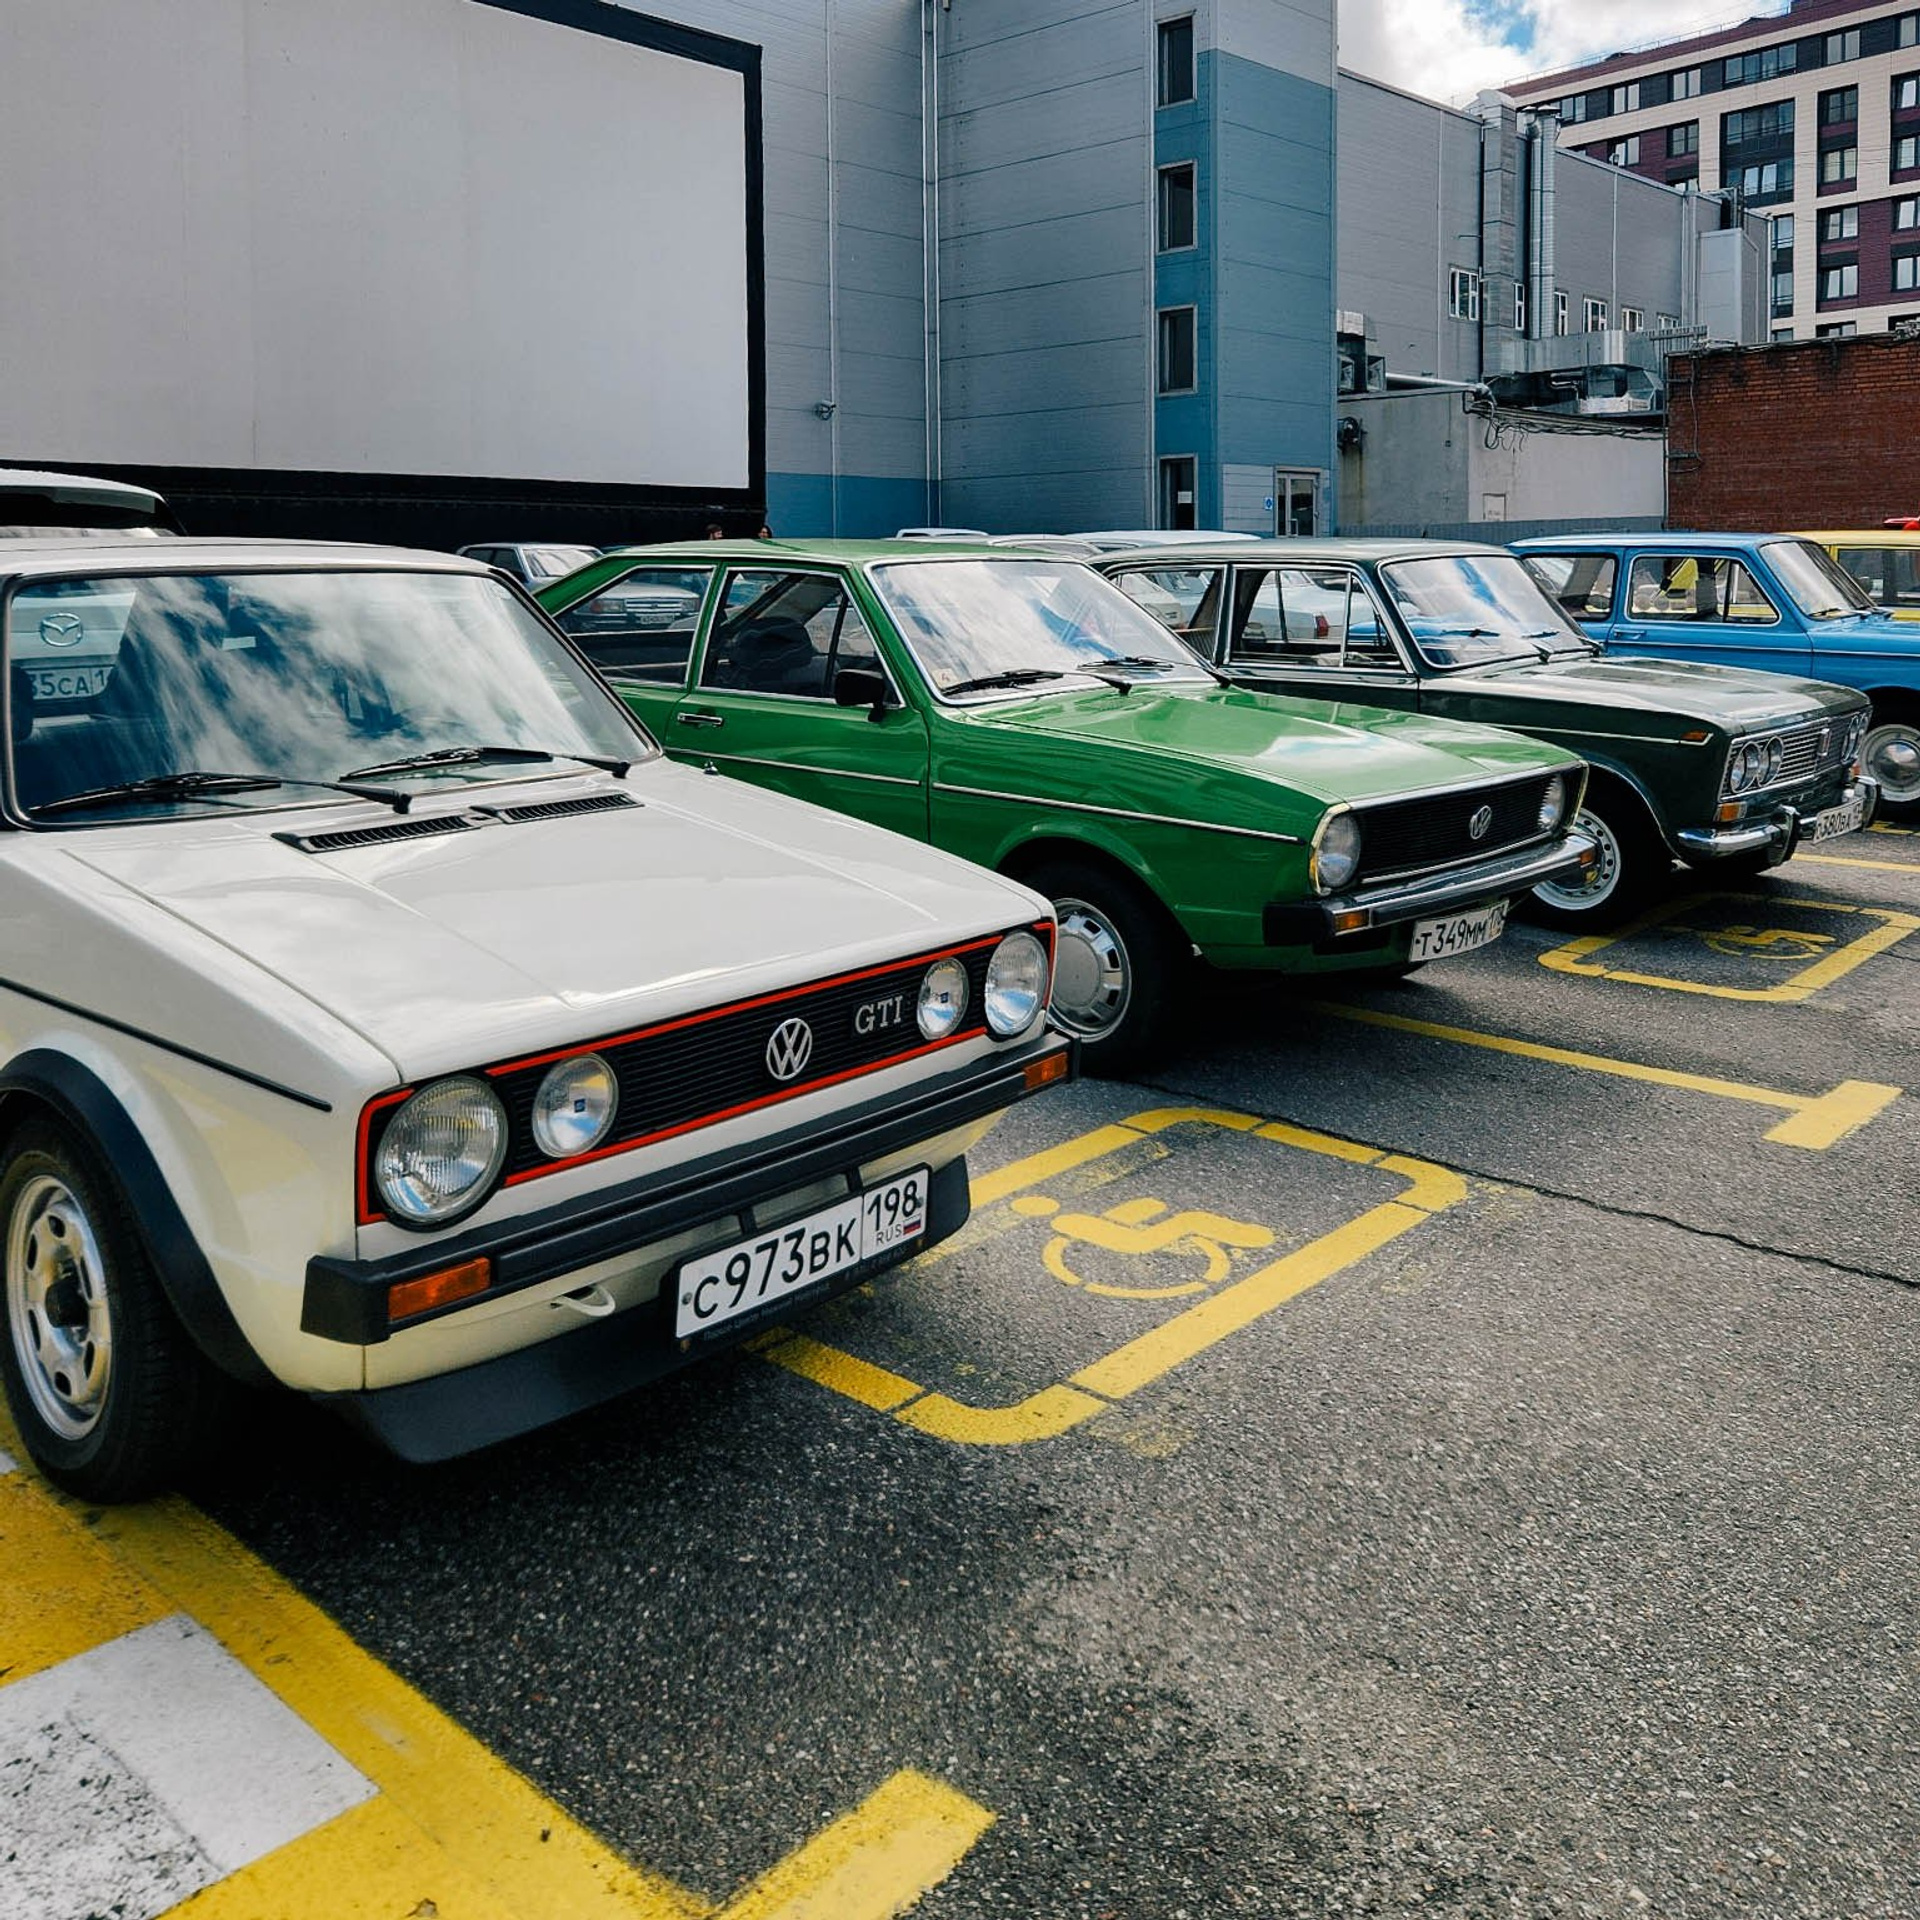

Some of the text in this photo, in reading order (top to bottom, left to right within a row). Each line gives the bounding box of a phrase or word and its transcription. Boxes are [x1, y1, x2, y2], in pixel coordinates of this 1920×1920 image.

[855, 995, 904, 1034] GTI
[765, 1017, 813, 1081] VW
[868, 1180, 919, 1231] 198
[876, 1226, 903, 1246] RUS
